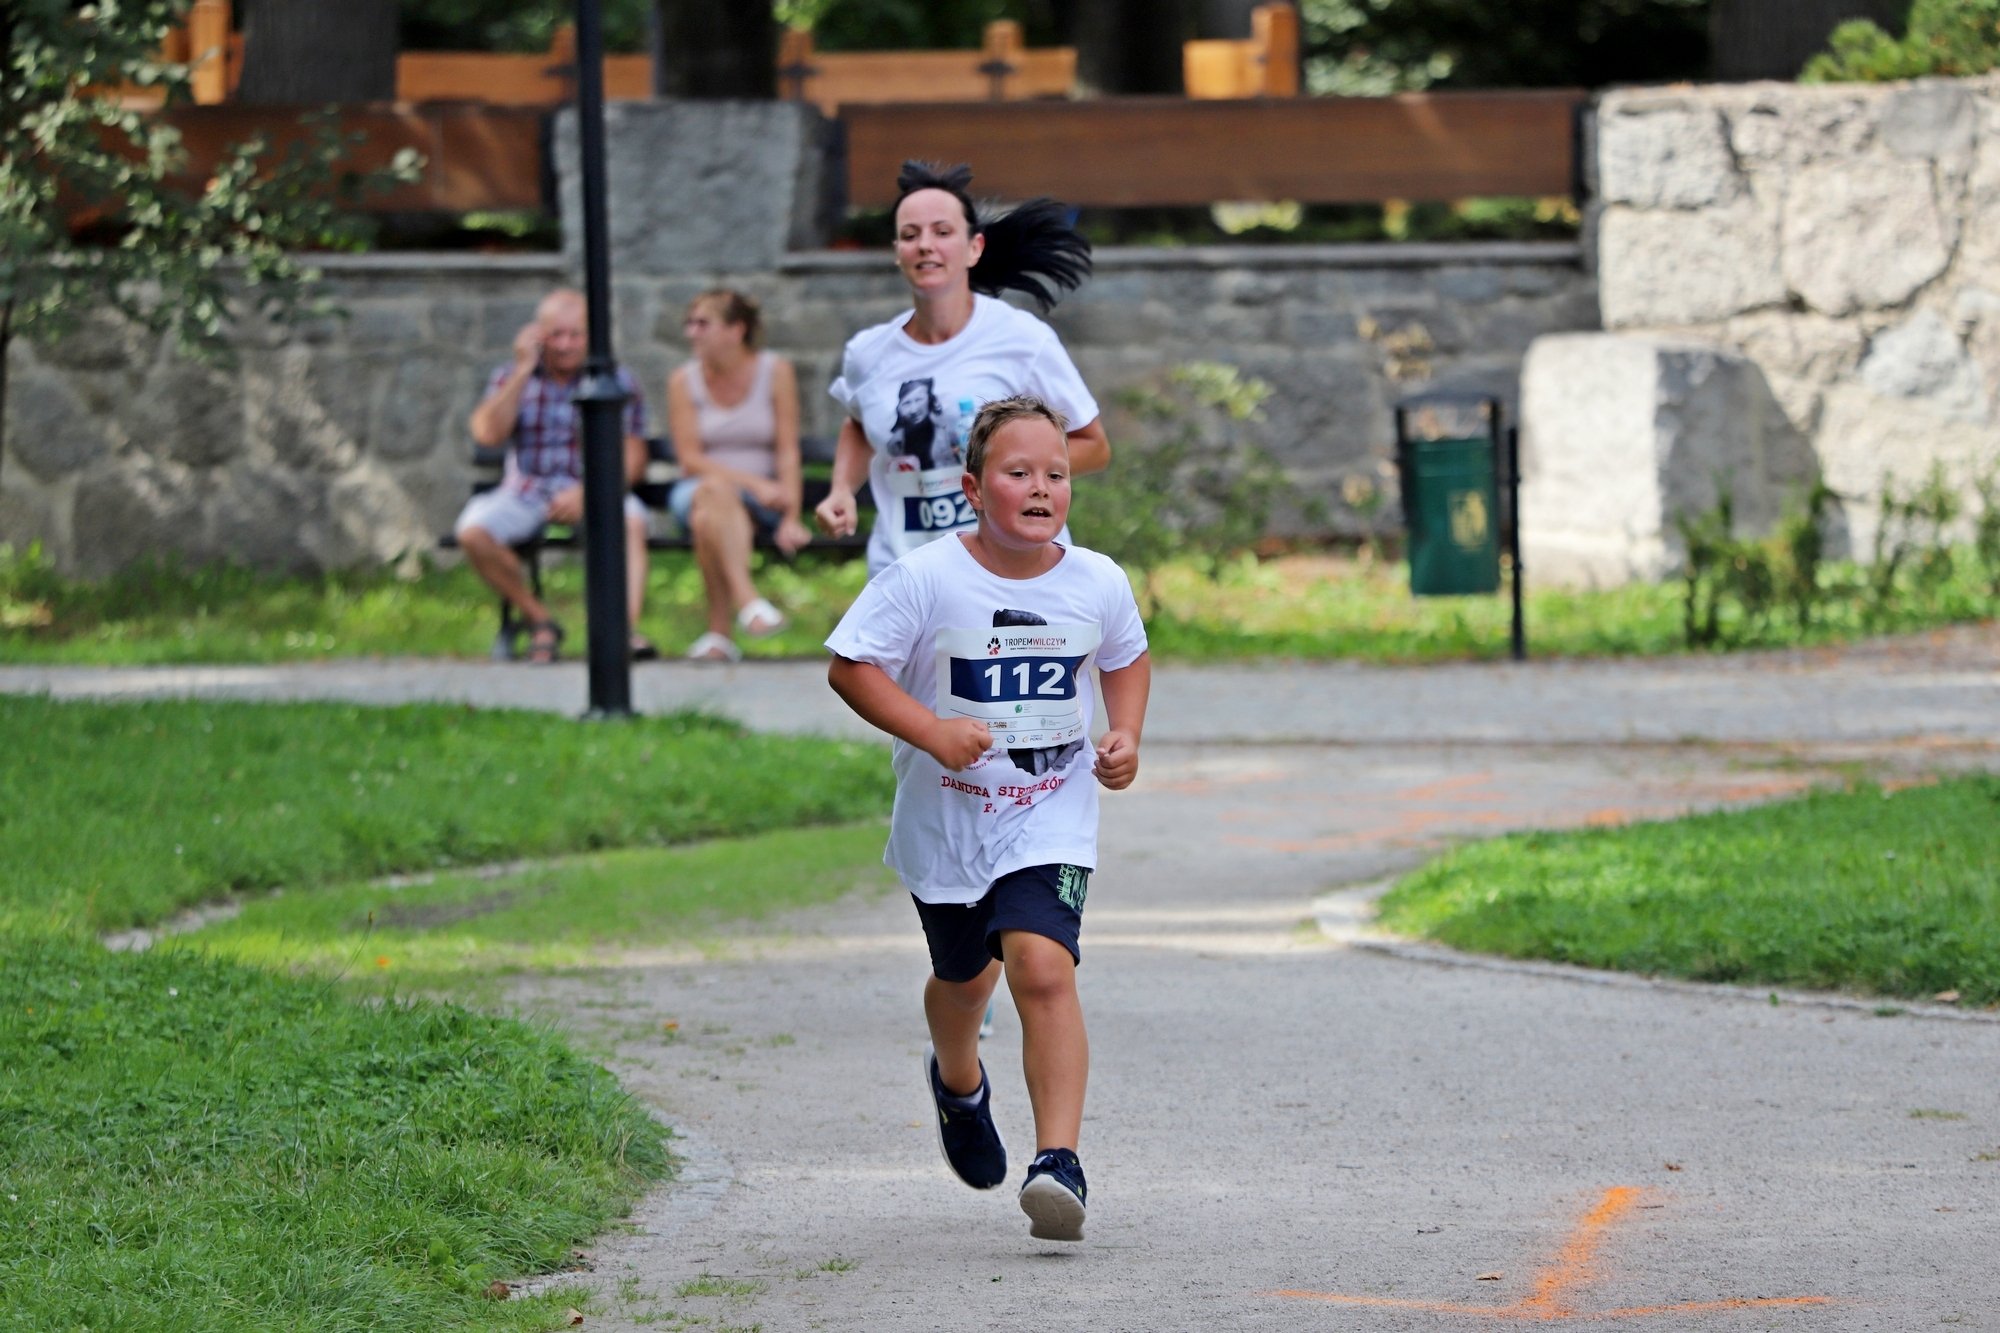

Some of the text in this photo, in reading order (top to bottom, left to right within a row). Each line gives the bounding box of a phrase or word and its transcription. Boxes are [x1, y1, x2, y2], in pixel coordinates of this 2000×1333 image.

[919, 492, 978, 528] 092
[984, 662, 1065, 697] 112
[941, 776, 990, 798] DANUTA
